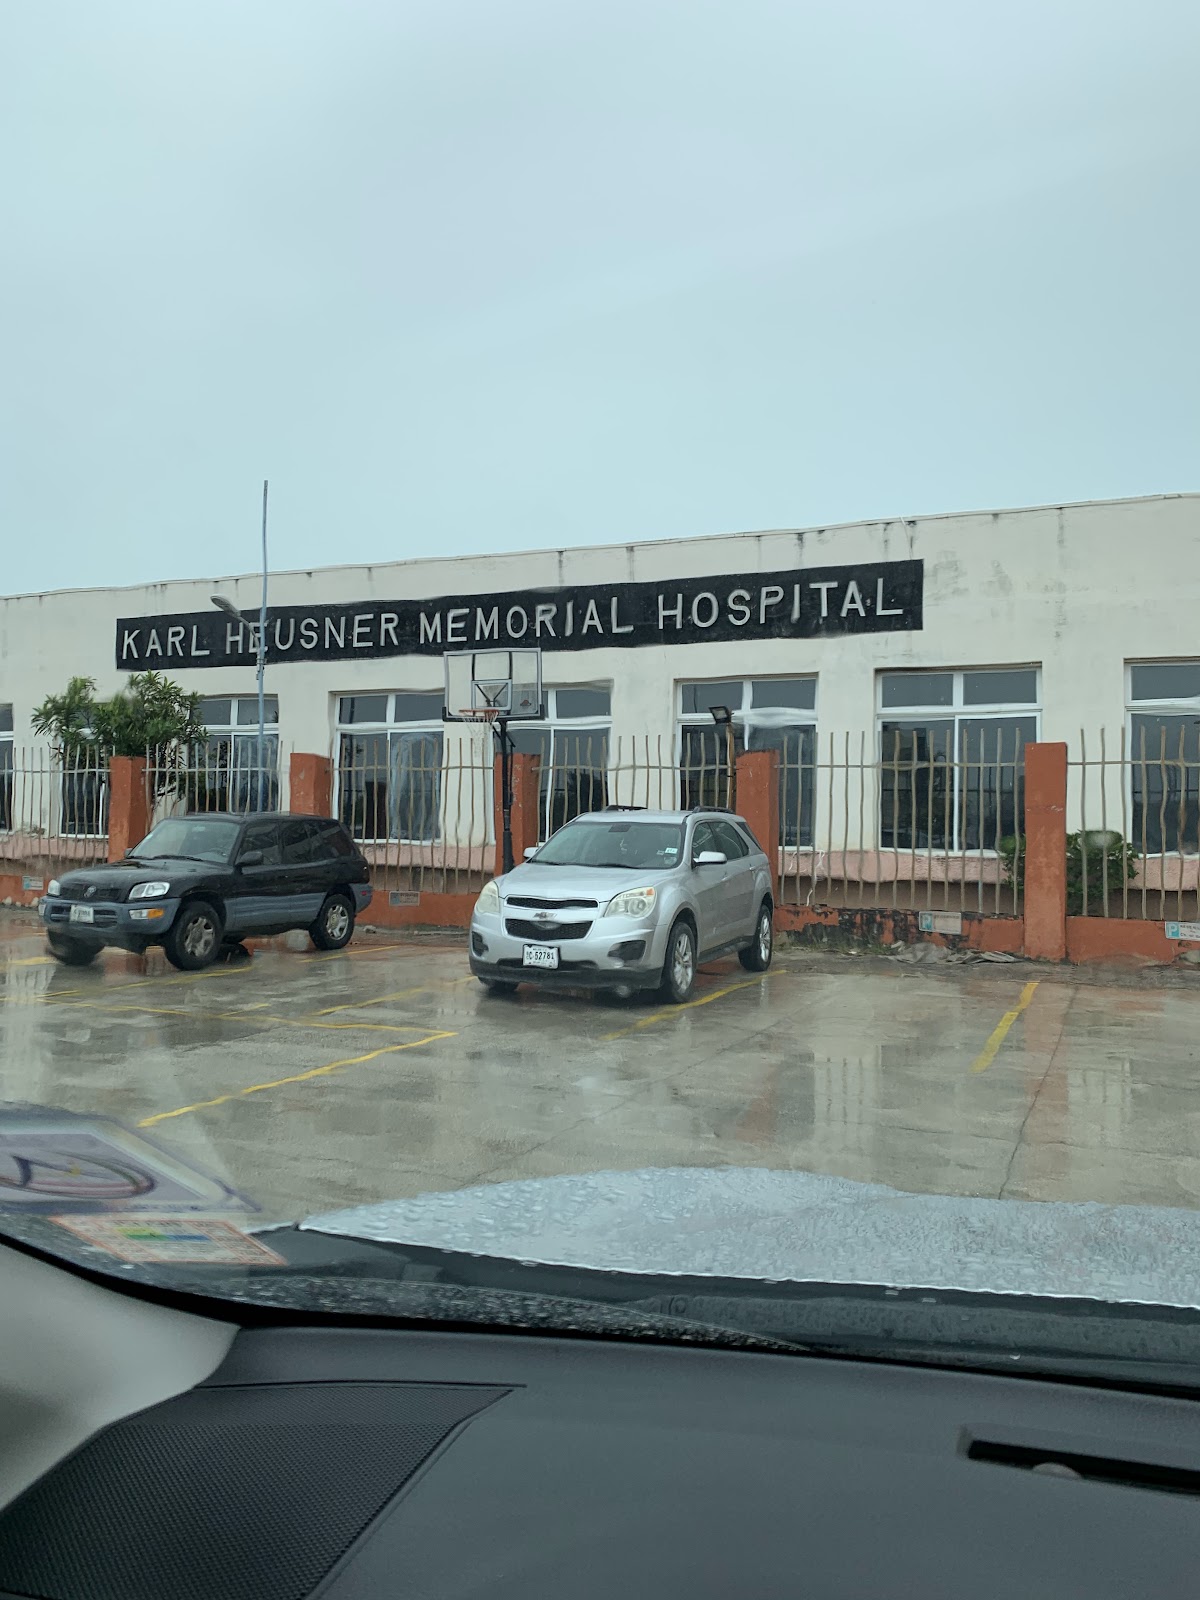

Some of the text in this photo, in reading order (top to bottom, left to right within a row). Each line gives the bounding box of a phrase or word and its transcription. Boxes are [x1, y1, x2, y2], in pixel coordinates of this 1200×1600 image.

[121, 578, 903, 660] KARL HEUSNER MEMORIAL HOSPITAL
[1168, 923, 1178, 937] P
